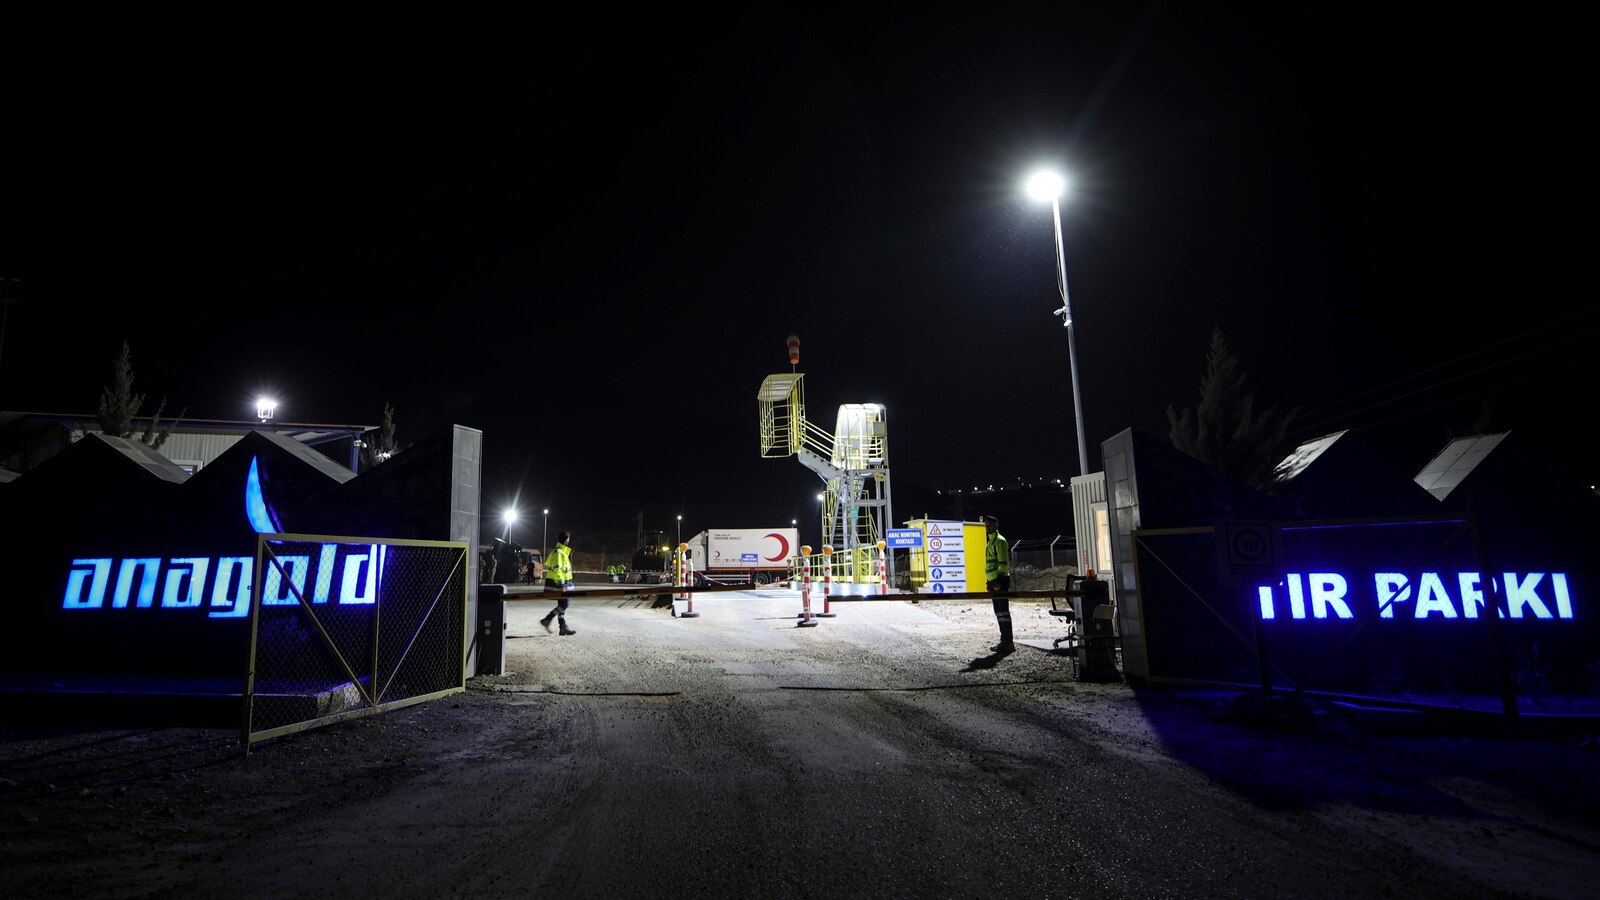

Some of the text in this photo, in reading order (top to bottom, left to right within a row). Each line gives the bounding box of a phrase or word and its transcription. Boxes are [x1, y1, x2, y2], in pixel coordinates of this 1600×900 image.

[1240, 539, 1259, 552] 10
[62, 544, 387, 618] anagold
[1375, 572, 1574, 619] PARKI
